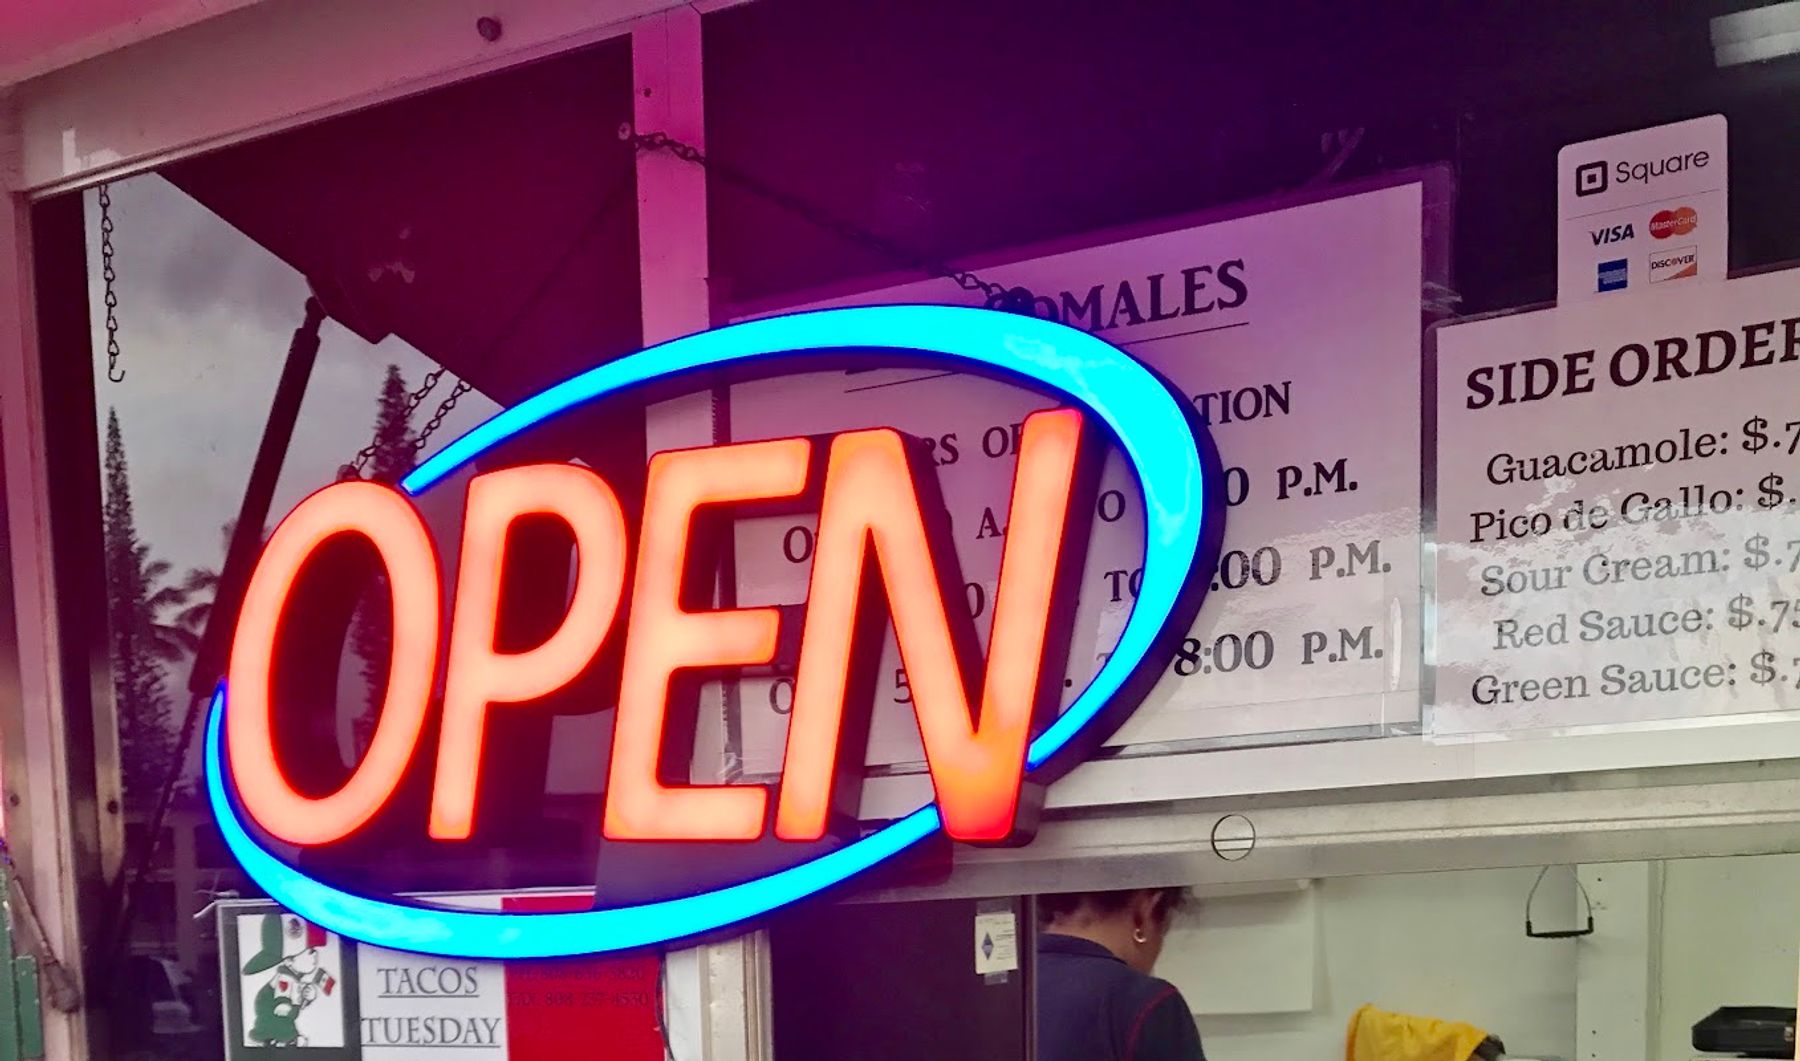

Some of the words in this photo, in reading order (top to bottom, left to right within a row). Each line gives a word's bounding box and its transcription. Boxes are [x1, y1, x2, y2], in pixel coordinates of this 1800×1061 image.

[1616, 150, 1710, 185] Square
[1589, 223, 1635, 246] VISA
[1651, 254, 1695, 270] DISCOVER
[1466, 350, 1596, 410] SIDE
[1486, 427, 1729, 486] Guacamole:
[1277, 458, 1358, 501] P.M.
[1469, 508, 1551, 543] Pico
[1563, 500, 1609, 532] de
[1621, 484, 1744, 526] Gallo:
[1309, 540, 1391, 581] P.M.
[1480, 564, 1573, 597] Sour
[1582, 546, 1731, 586] Cream:
[226, 408, 1084, 846] OPEN
[1493, 614, 1570, 651] Red
[1579, 605, 1714, 643] Sauce:
[1174, 630, 1275, 677] 8:00
[1301, 626, 1384, 665] P.M.
[1472, 674, 1591, 706] Green
[1600, 663, 1737, 696] Sauce:
[376, 966, 479, 996] TACOS
[361, 1015, 501, 1044] TUESDAY
